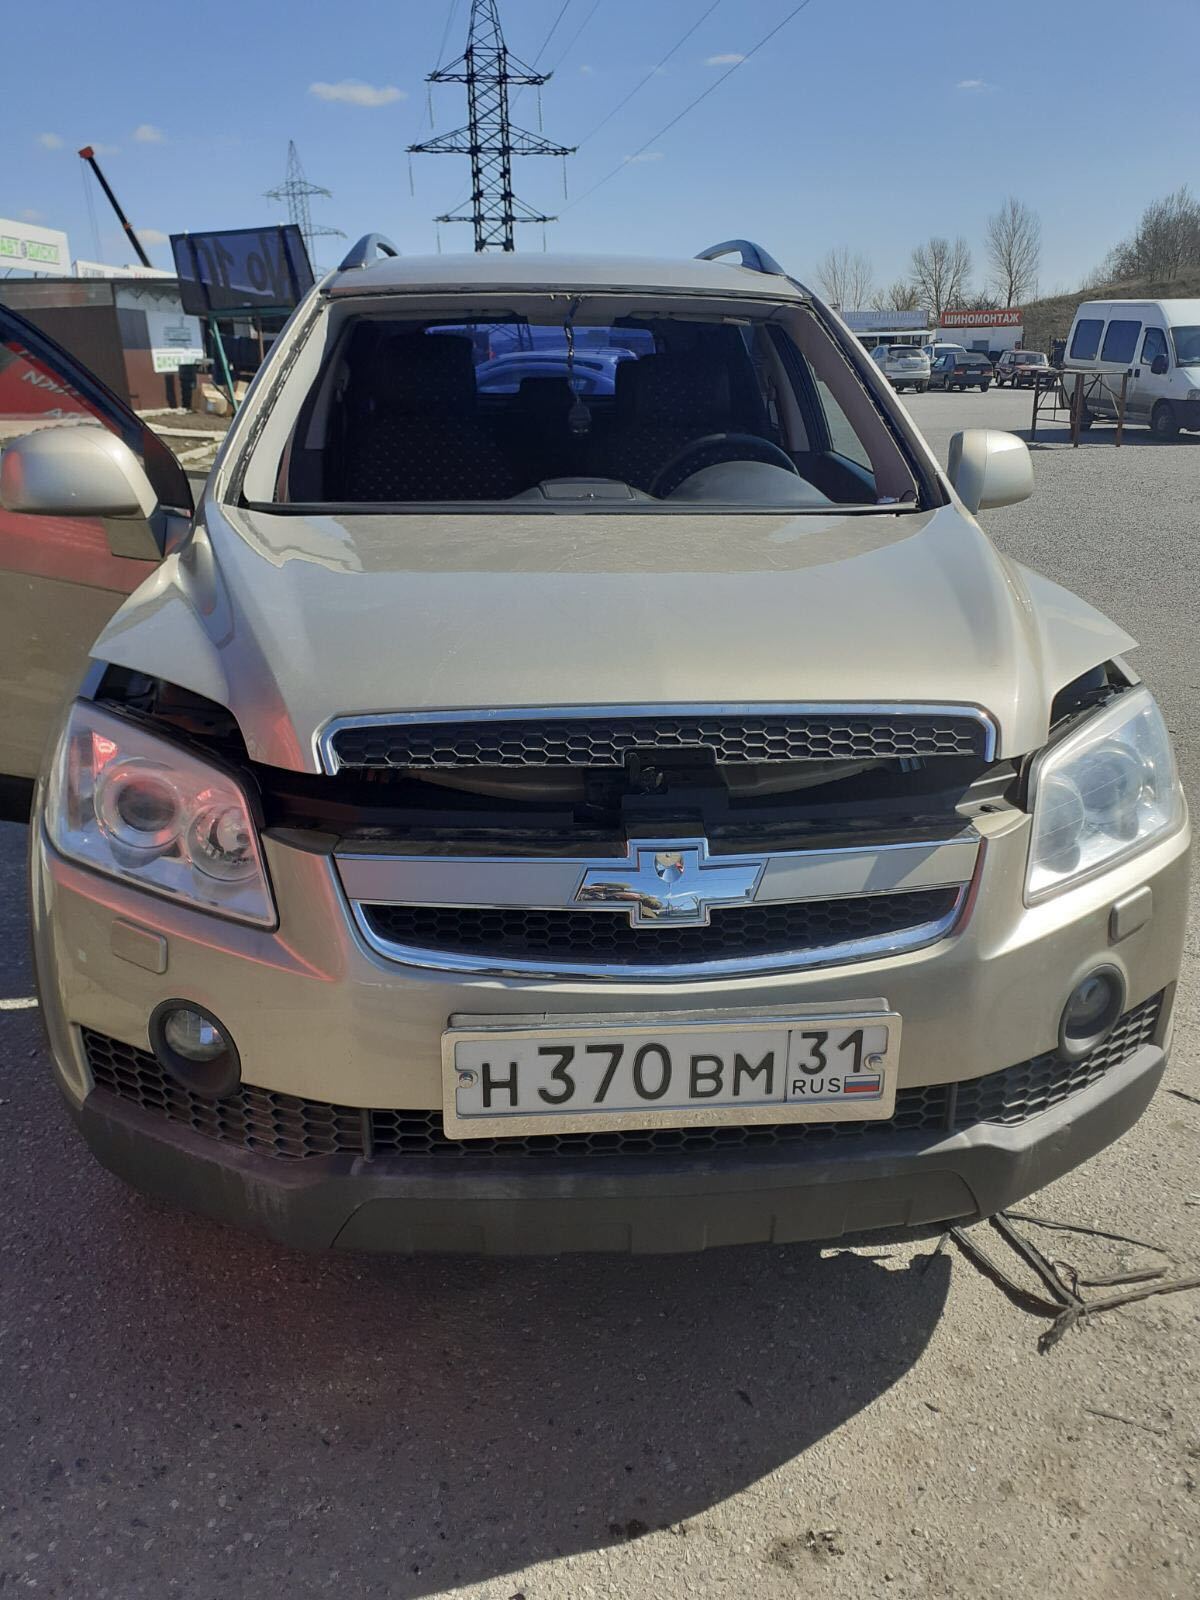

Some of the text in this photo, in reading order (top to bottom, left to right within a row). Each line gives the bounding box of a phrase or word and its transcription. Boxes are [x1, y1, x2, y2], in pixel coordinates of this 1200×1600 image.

[944, 312, 1020, 325] ШИНОМОНТАЖ
[799, 1029, 865, 1076] 31
[792, 1077, 842, 1096] RUS
